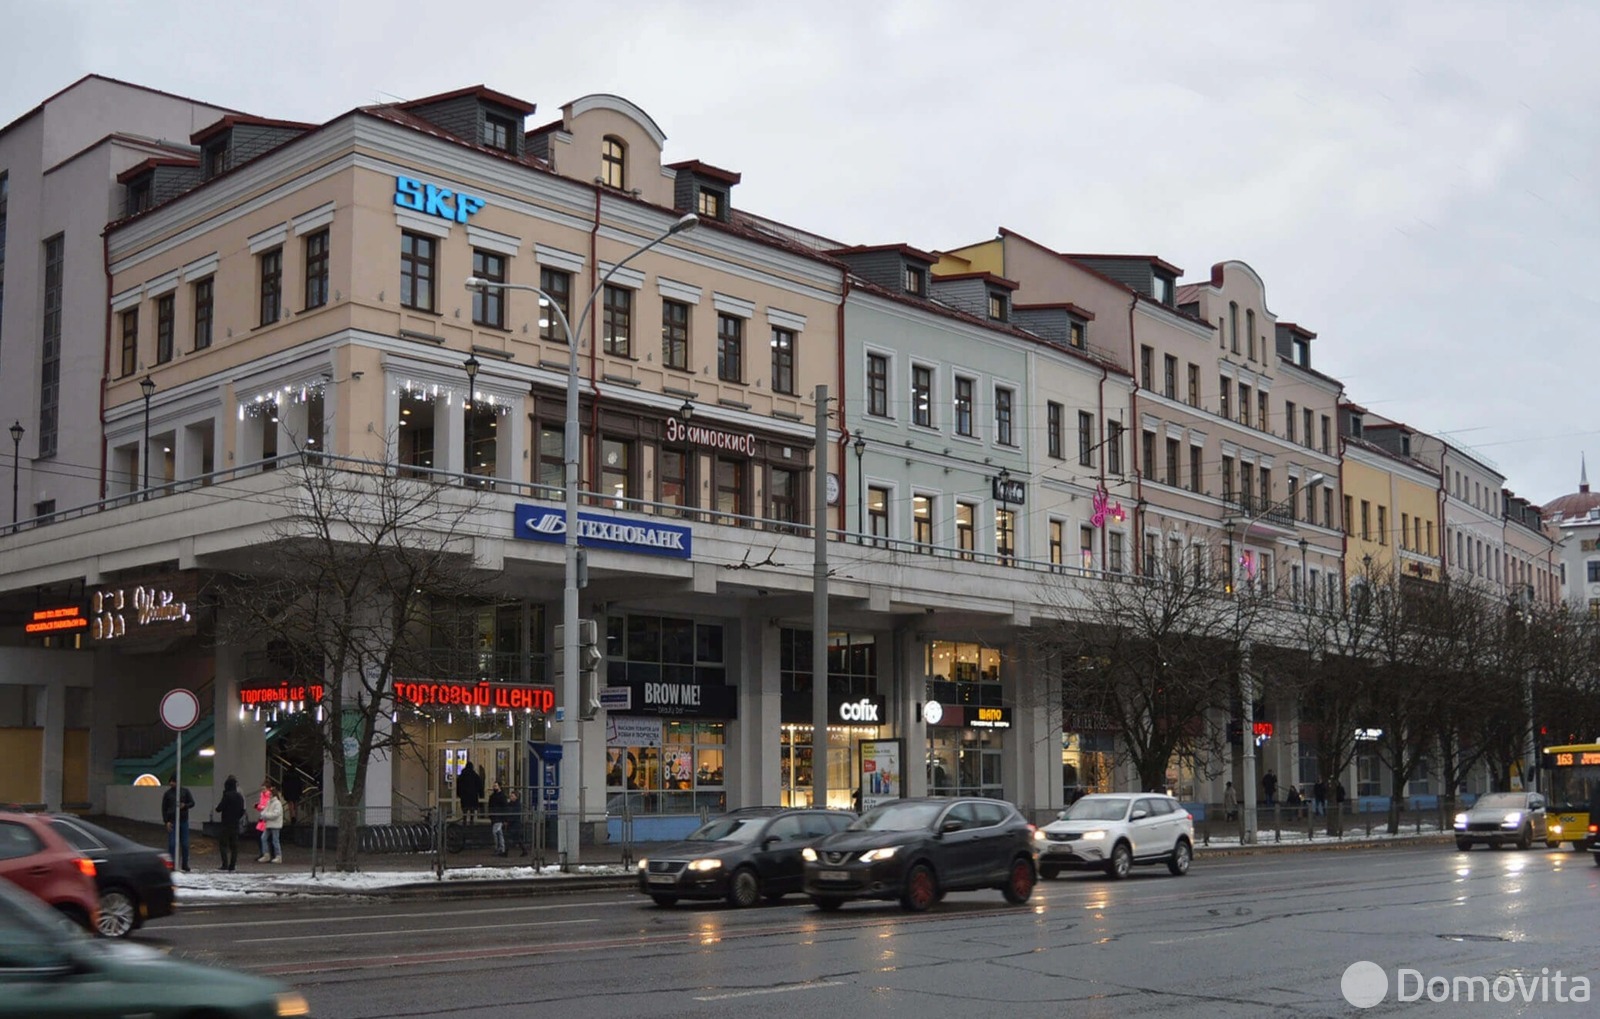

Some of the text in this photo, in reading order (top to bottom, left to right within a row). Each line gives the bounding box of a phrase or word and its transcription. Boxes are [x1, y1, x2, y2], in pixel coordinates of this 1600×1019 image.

[394, 175, 486, 224] SKF
[577, 519, 685, 550] ТЕХНОБАНК
[290, 685, 323, 703] цетр
[644, 682, 701, 706] BROW ME!
[840, 698, 878, 721] cofix
[1556, 753, 1573, 766] 163
